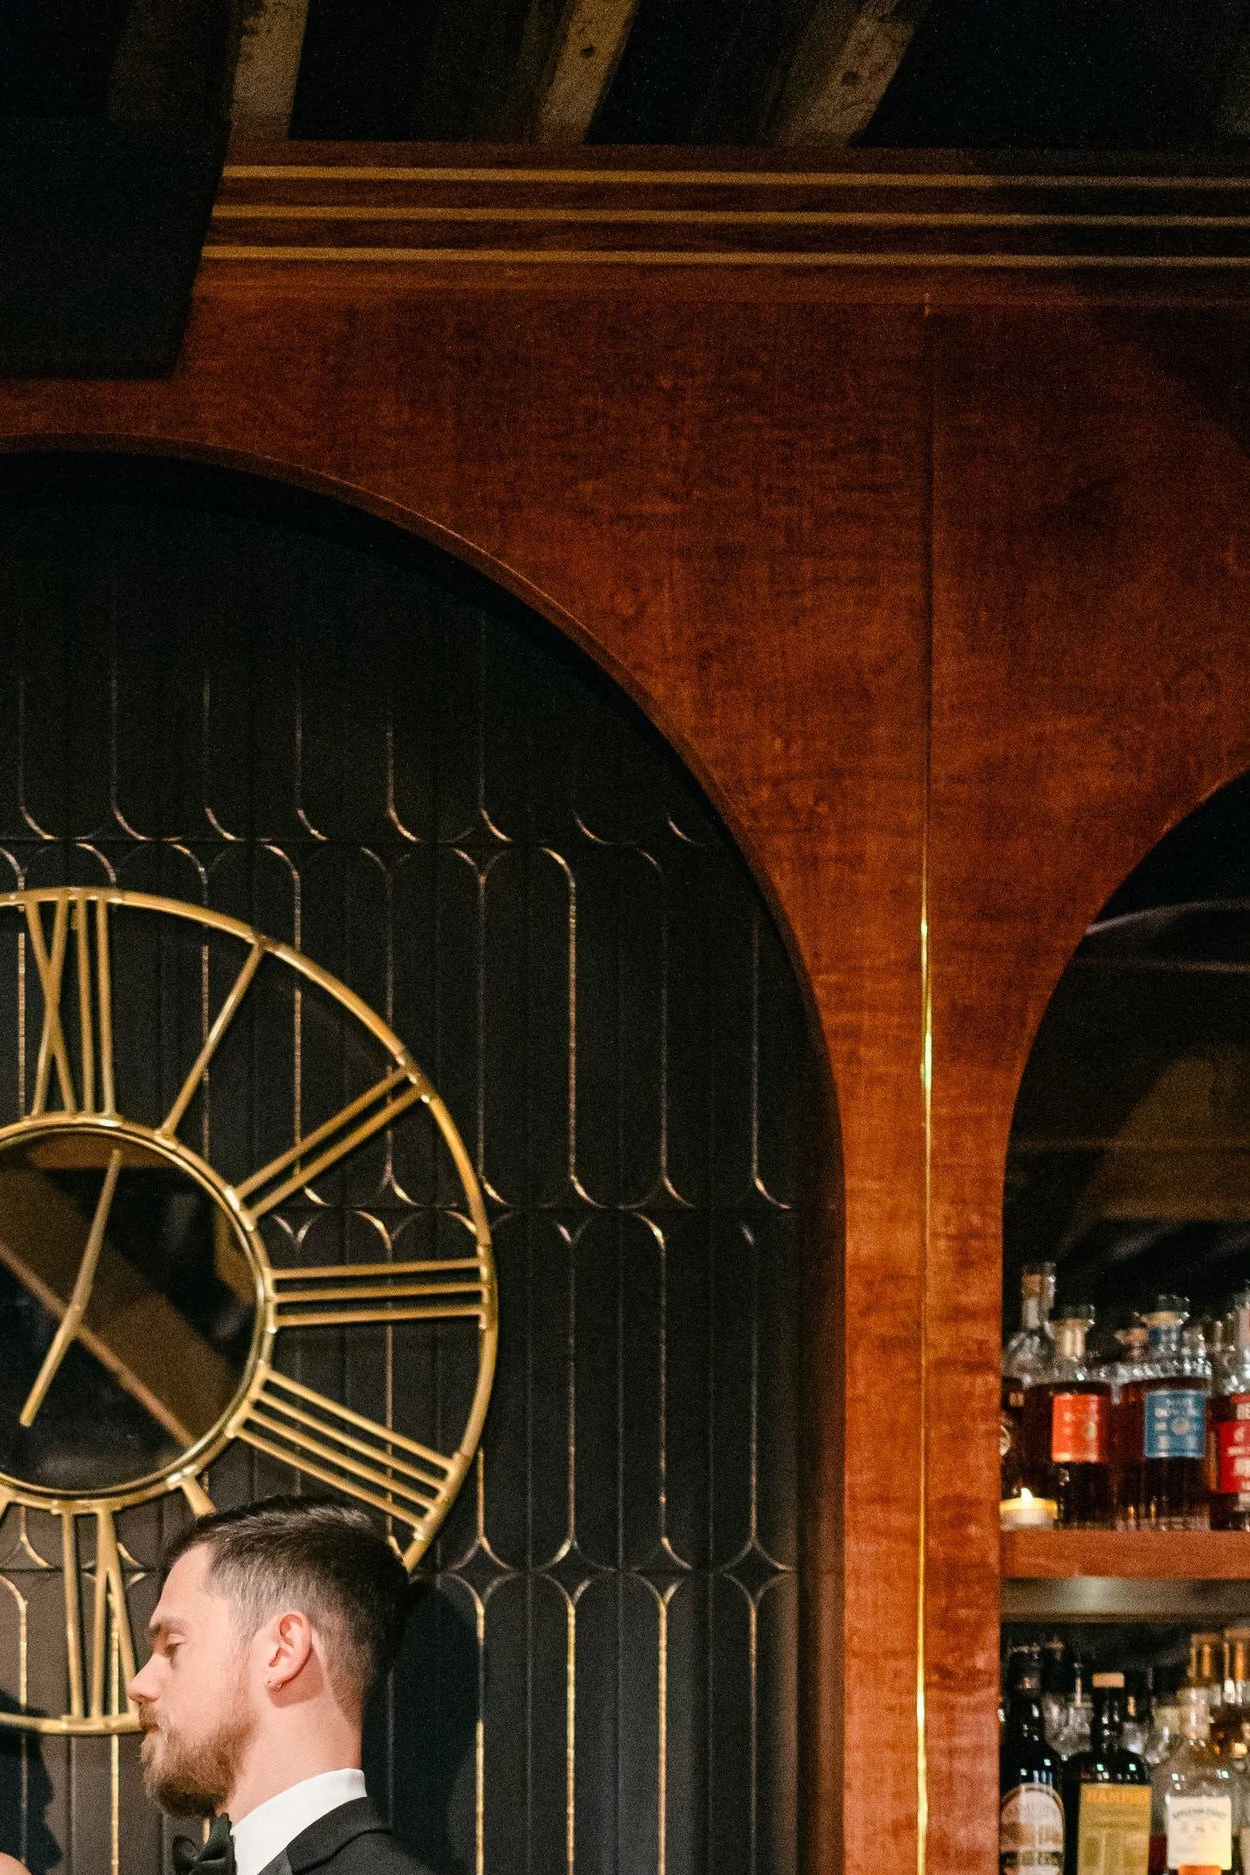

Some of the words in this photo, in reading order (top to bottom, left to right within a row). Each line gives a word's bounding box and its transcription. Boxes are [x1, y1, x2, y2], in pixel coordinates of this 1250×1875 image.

[20, 895, 121, 1120] XII
[236, 1066, 426, 1222] II
[271, 1257, 489, 1330] III
